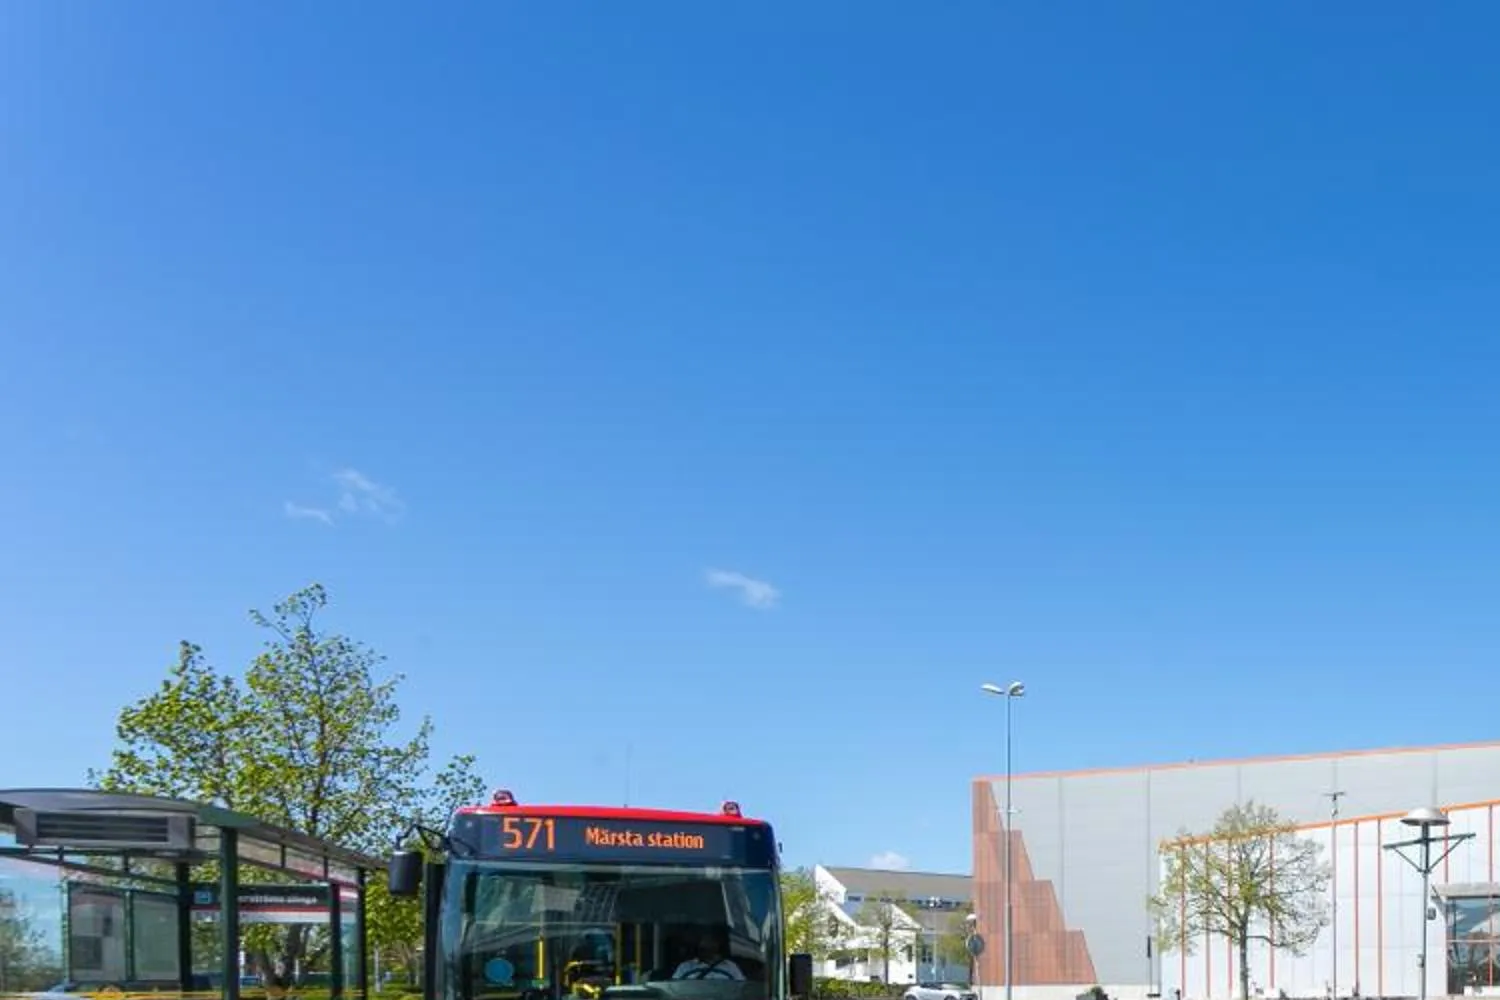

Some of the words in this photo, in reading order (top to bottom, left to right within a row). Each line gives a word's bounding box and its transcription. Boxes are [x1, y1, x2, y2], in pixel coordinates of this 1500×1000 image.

[502, 816, 556, 850] 571
[584, 826, 643, 847] Märsta
[647, 831, 704, 849] station
